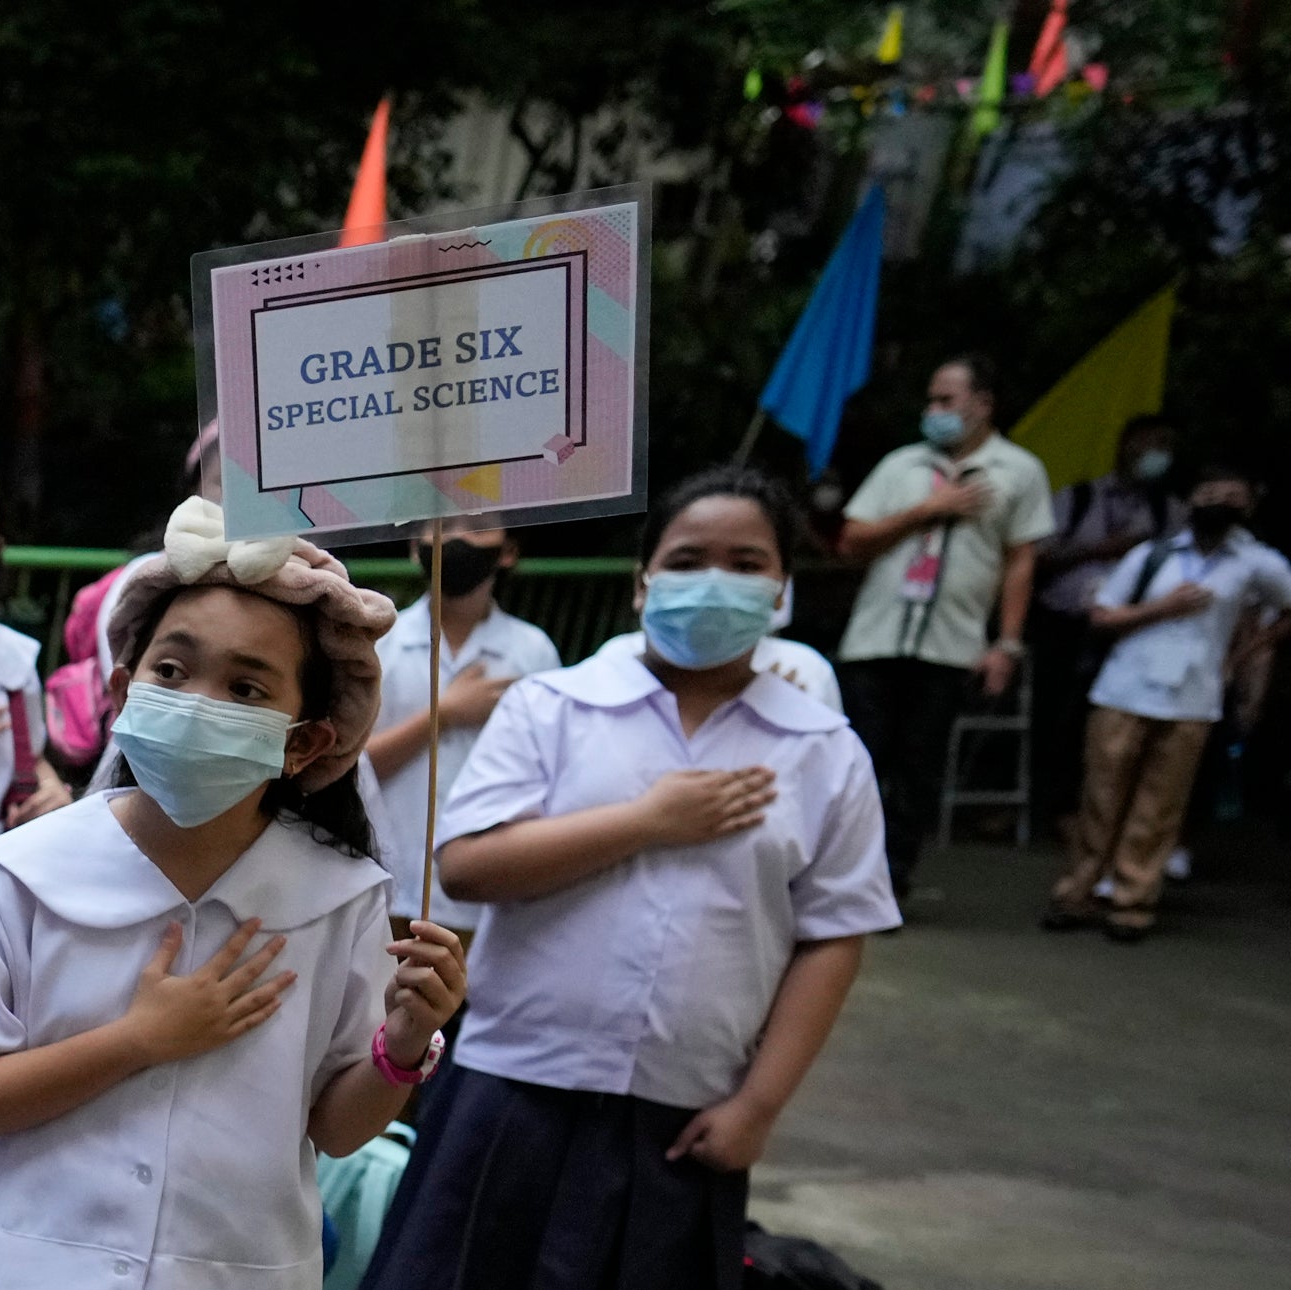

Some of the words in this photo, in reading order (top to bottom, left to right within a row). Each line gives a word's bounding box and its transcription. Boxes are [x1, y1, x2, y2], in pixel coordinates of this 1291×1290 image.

[300, 337, 441, 384] GRADE
[455, 325, 523, 364] SIX
[266, 390, 403, 431] SPECIAL
[413, 369, 560, 412] SCIENCE
